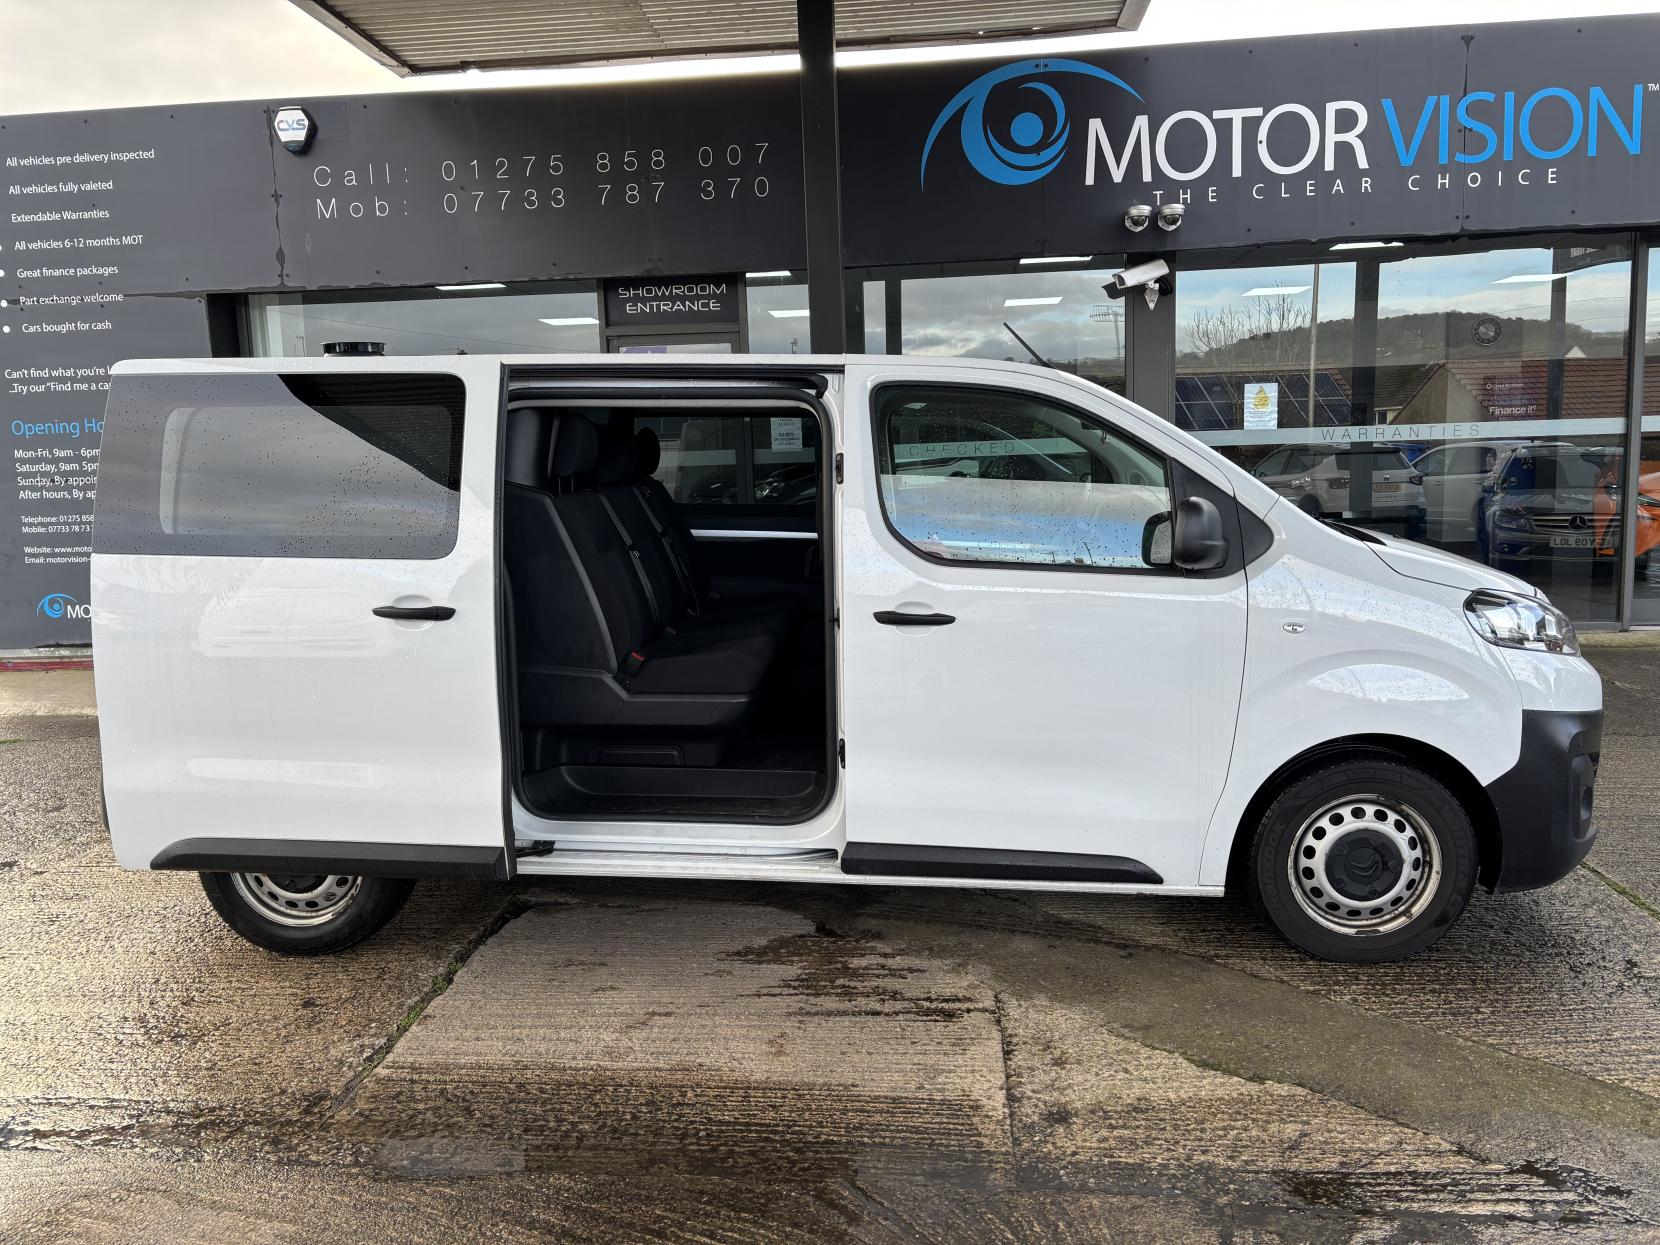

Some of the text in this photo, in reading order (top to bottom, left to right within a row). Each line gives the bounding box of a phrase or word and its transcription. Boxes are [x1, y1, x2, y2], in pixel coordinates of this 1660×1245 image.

[277, 118, 306, 131] CVS
[6, 149, 155, 167] All vehicles pre delivery inspected
[313, 142, 769, 187] Call: 01275 858 007
[9, 180, 113, 195] All vehicles fully valeted
[1153, 168, 1557, 206] THE CLEAR CHOICE
[316, 176, 769, 220] Mob: 07733 787 370
[11, 209, 110, 223] Extendable Warranties
[14, 234, 143, 251] All vehicles 6-12 months MOT
[17, 265, 119, 278] Great finance packages
[618, 283, 727, 299] SHOWROOM
[20, 293, 124, 306] Part exchange welcome
[626, 299, 721, 314] ENTRANCE
[22, 320, 112, 334] Cars bought for cash
[4, 368, 29, 379] Can't
[30, 367, 49, 378] find
[51, 367, 75, 377] what
[76, 366, 105, 379] you're
[29, 384, 45, 392] our
[73, 382, 88, 391] me
[1489, 406, 1526, 415] Finance
[11, 418, 80, 438] Opening
[1321, 423, 1480, 441] WARRANTIES
[14, 448, 52, 459] Mon-Fri,
[53, 448, 73, 457] 9am
[909, 441, 1016, 458] CHECKED
[16, 462, 57, 473] Saturday,
[59, 462, 79, 471] 9am
[17, 474, 52, 487] Sunday,
[54, 475, 65, 486] By
[19, 489, 41, 499] After
[43, 489, 71, 499] hours,
[72, 488, 84, 500] By
[20, 515, 59, 524] Telephone:
[59, 515, 80, 523] 01275
[22, 525, 48, 533] Mobile:
[48, 525, 69, 533] 07733
[23, 546, 53, 554] Website:
[25, 556, 46, 564] Email:
